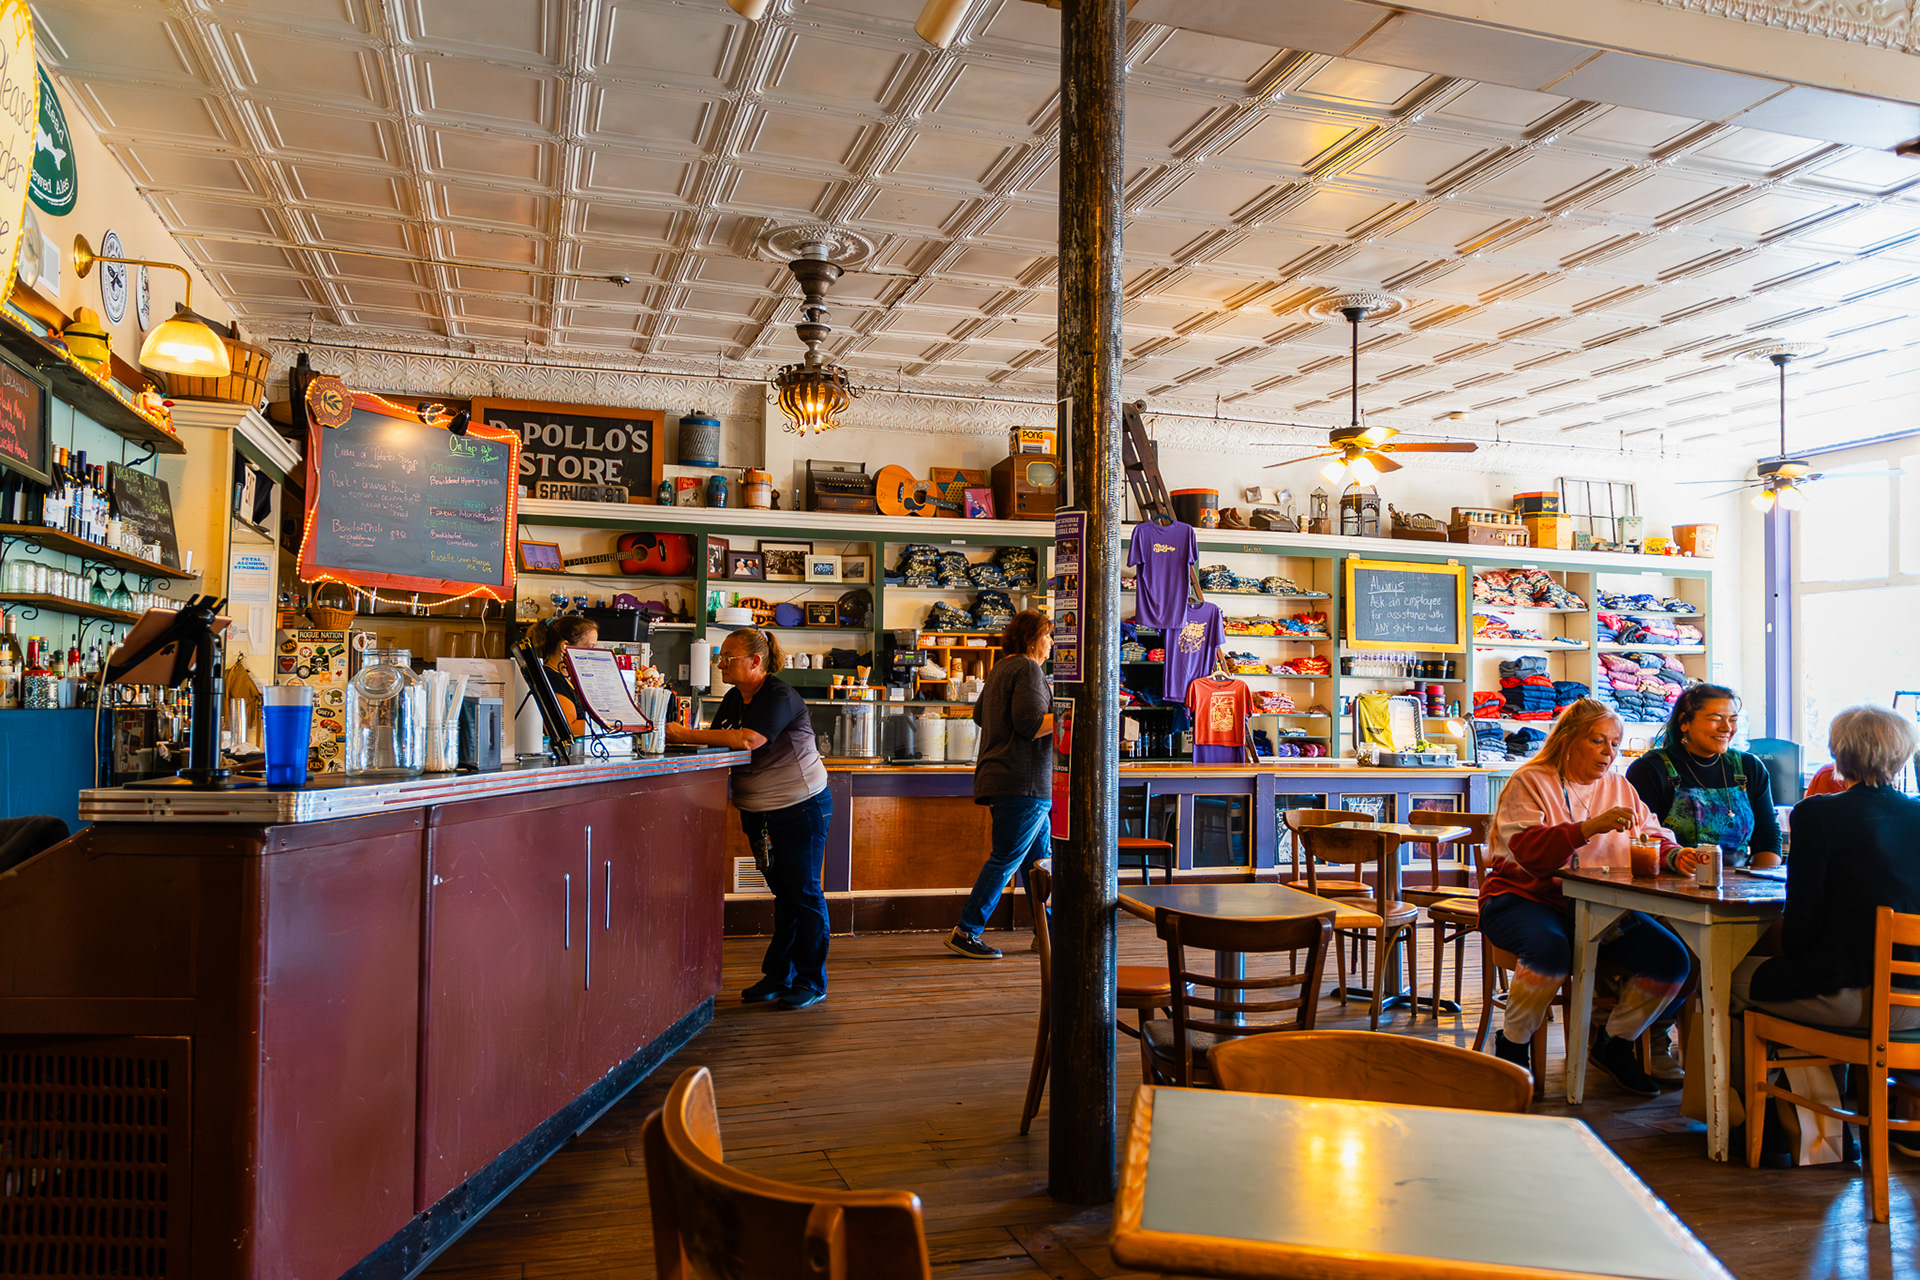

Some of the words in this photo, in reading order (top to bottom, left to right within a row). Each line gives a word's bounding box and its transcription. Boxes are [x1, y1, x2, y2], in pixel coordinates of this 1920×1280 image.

[0, 134, 25, 193] der
[1022, 431, 1043, 439] PONG
[519, 452, 623, 485] STORE
[540, 483, 598, 501] SPRUCE
[1369, 575, 1405, 597] Always
[1370, 594, 1386, 609] Ask
[1388, 598, 1401, 608] an
[1404, 593, 1442, 610] employee
[1371, 608, 1381, 620] for
[1386, 608, 1427, 621] assistance
[1429, 609, 1444, 619] with
[299, 631, 319, 639] ROGUE
[1374, 622, 1390, 634] ANY
[1393, 622, 1415, 633] shirts
[309, 761, 323, 769] KIN
